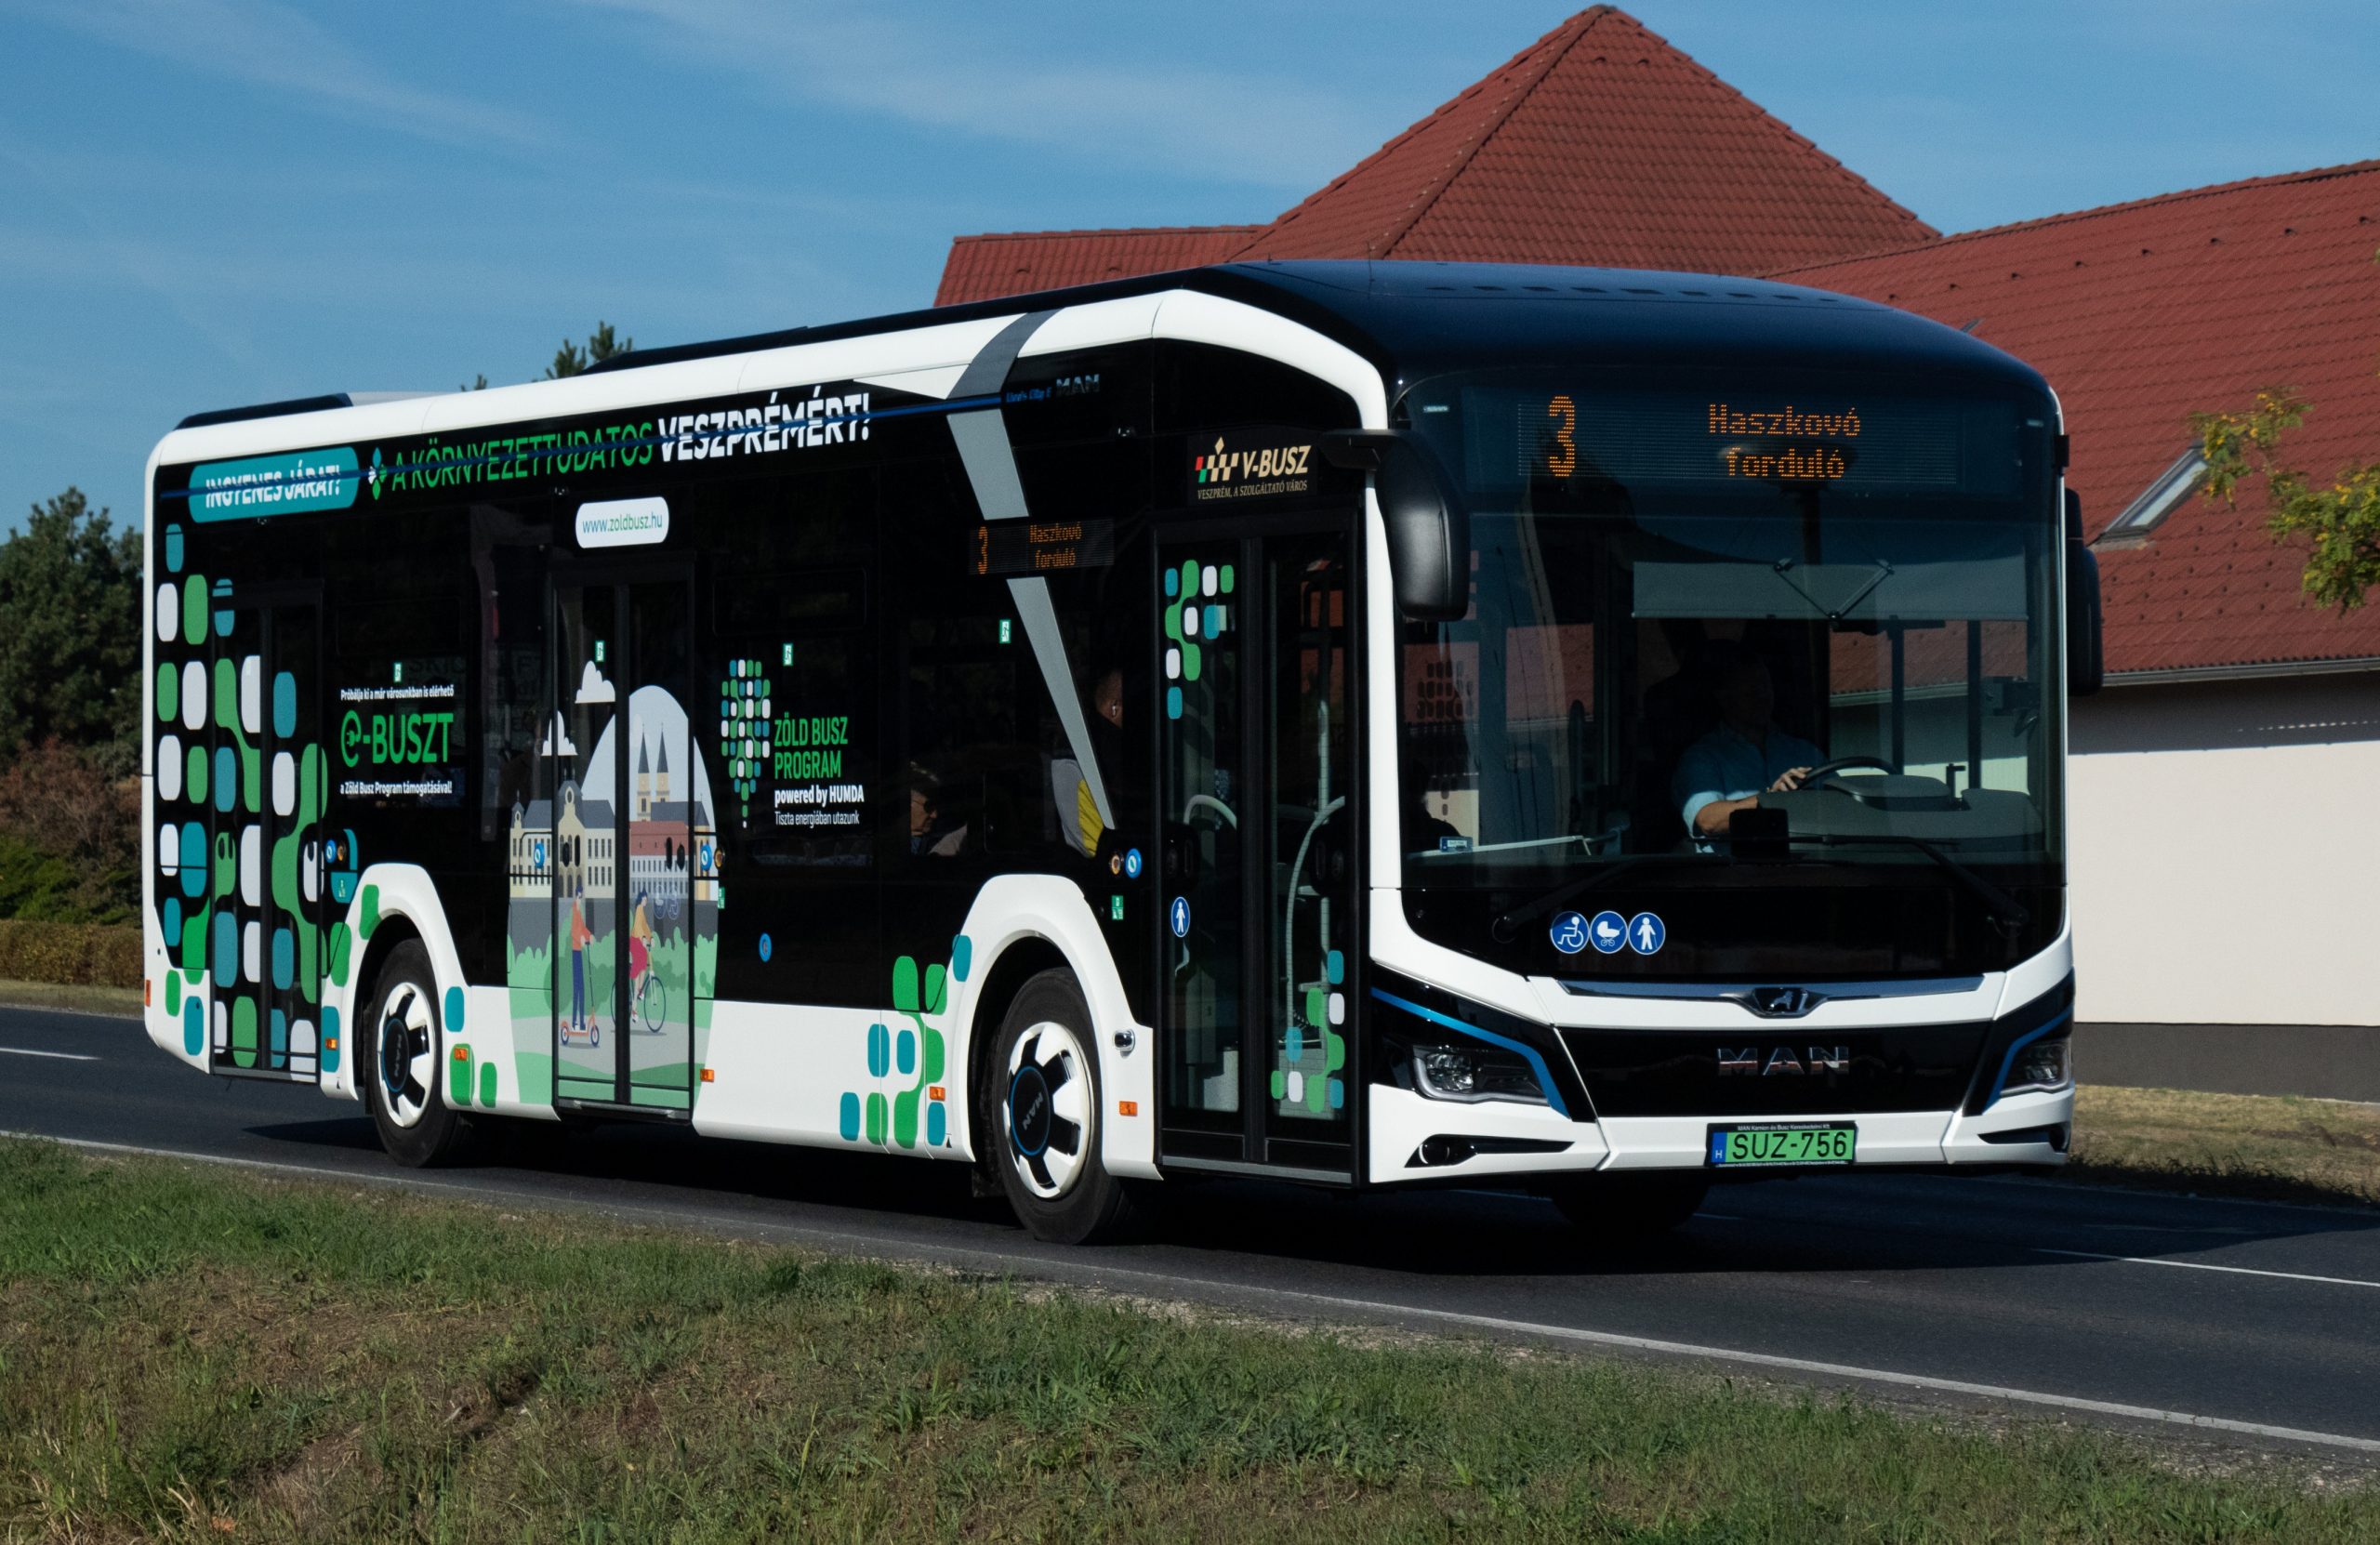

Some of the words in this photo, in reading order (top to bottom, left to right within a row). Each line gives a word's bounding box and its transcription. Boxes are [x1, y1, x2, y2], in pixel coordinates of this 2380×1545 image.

[1056, 374, 1100, 396] MAN
[392, 453, 406, 491] A
[412, 422, 653, 489] KÖRNYEZETTUDATOS
[658, 386, 870, 462] VESZPRÉMÉRT!
[1548, 395, 1576, 477] 3
[1708, 403, 1860, 437] Haszkovó
[1243, 445, 1311, 479] V-BUSZ
[1726, 447, 1844, 480] forduló
[205, 471, 283, 508] INGYENES
[284, 459, 340, 500] JÁRAT!
[1233, 487, 1238, 496] A
[1239, 481, 1285, 496] SZOLGÁLTATÓ
[1286, 479, 1307, 492] VÁROS
[582, 511, 663, 534] www.zoldbusz.hu
[977, 526, 988, 574] 3
[1029, 521, 1082, 543] Haszkovó
[341, 688, 364, 702] Próbálja
[364, 688, 370, 699] ki
[374, 687, 386, 699] már
[387, 686, 423, 699] városunkban
[423, 685, 429, 697] is
[430, 683, 454, 697] elérhető
[774, 711, 808, 746] ZÖLD
[812, 716, 848, 746] BUSZ
[774, 750, 841, 779] PROGRAM
[345, 781, 359, 794] Zöld
[360, 781, 374, 794] Busz
[375, 781, 402, 798] Program
[403, 780, 453, 797] támogatásával!
[774, 785, 814, 809] powered
[815, 785, 827, 808] by
[829, 785, 865, 802] HUMDA
[774, 811, 794, 825] Tiszta
[795, 810, 832, 829] energiában
[832, 809, 860, 825] utazunk
[1717, 1046, 1850, 1076] MAN
[1715, 1150, 1723, 1158] H
[1732, 1131, 1847, 1160] SUZ-756
